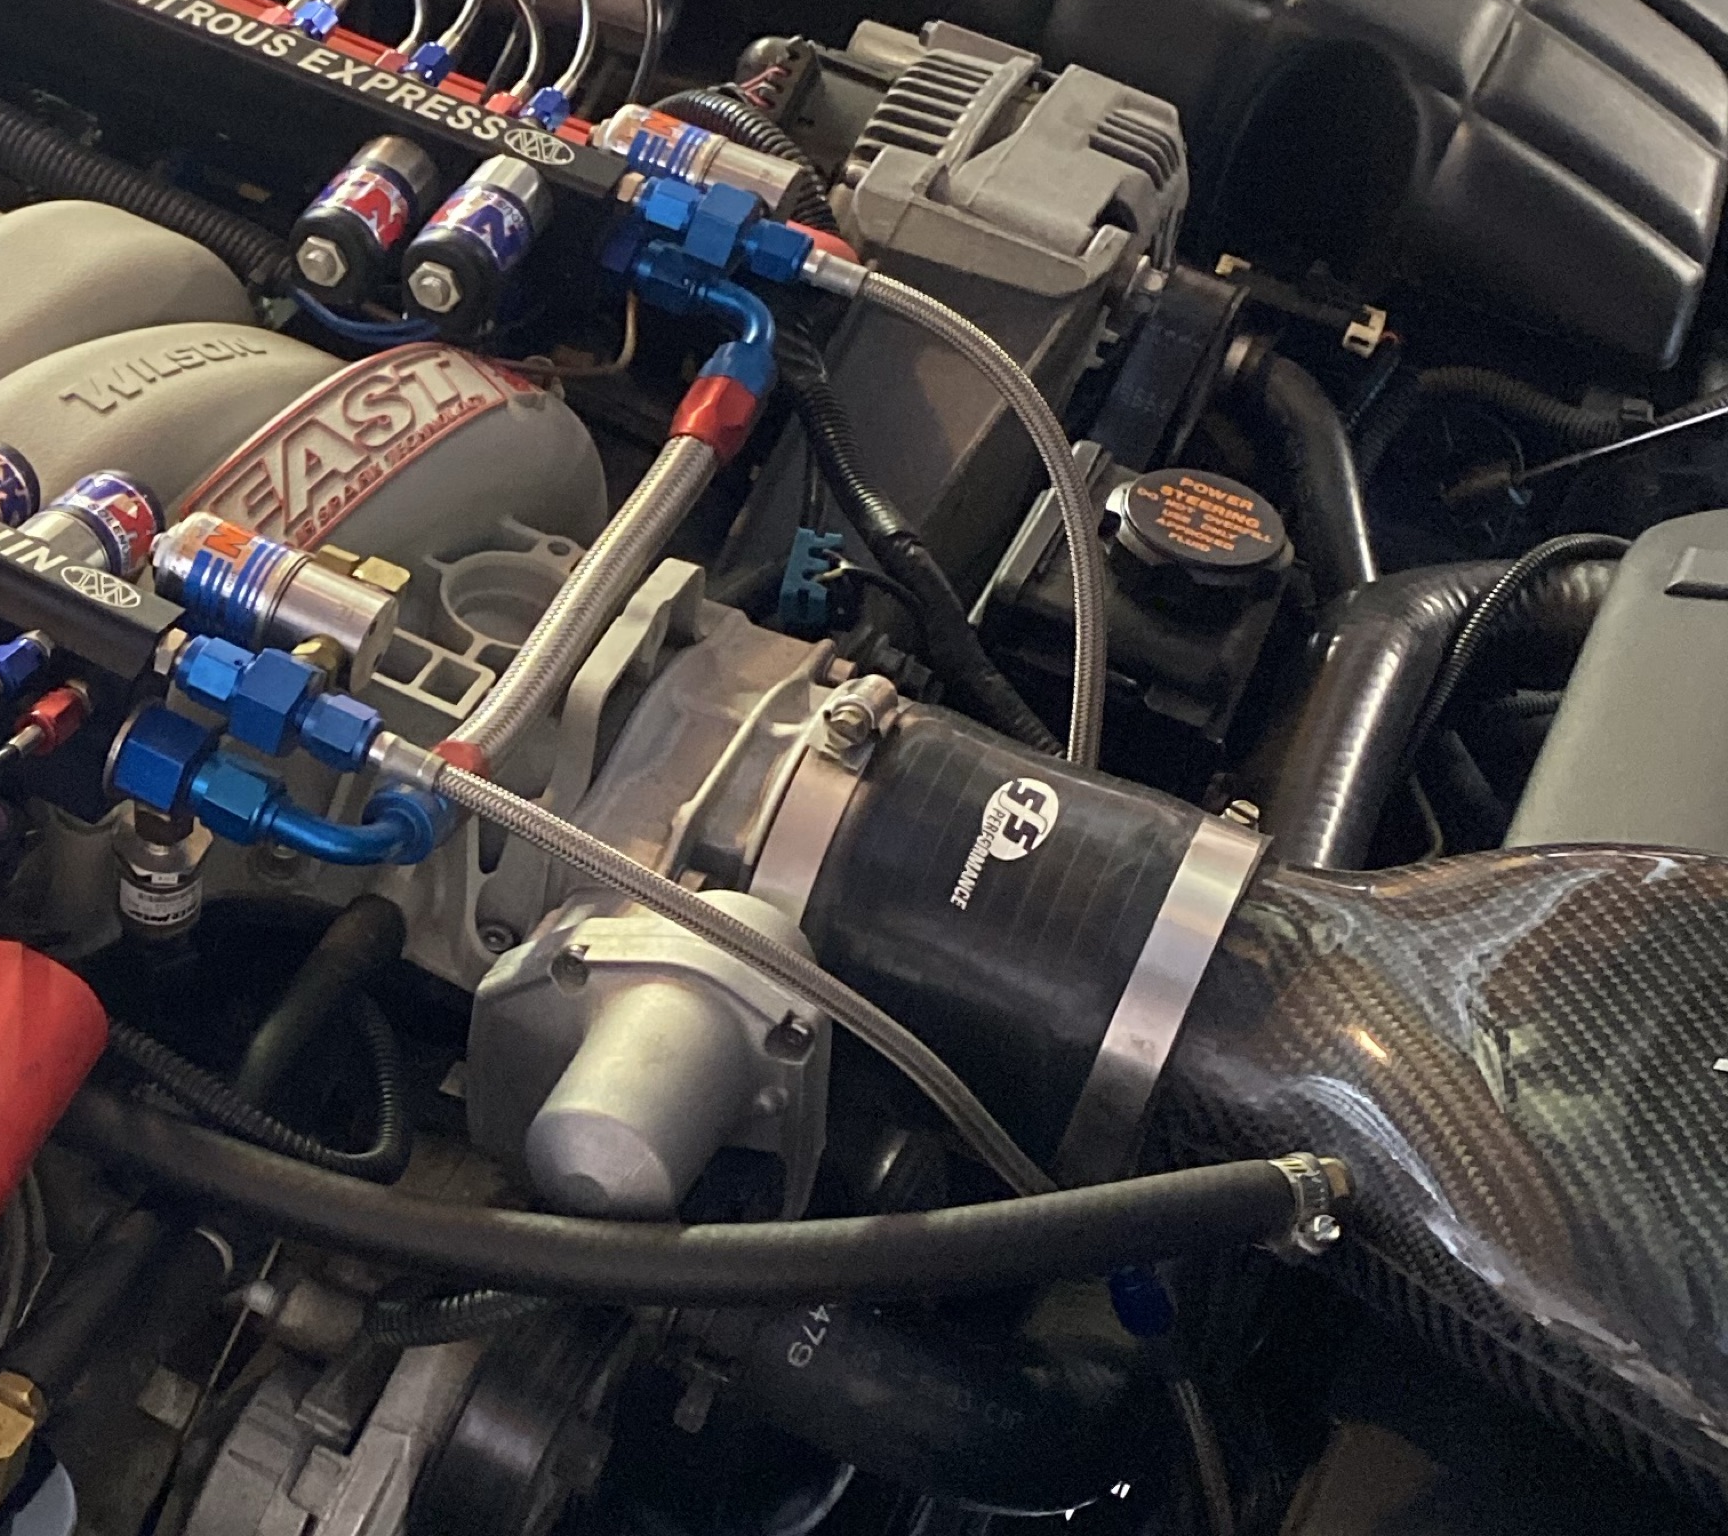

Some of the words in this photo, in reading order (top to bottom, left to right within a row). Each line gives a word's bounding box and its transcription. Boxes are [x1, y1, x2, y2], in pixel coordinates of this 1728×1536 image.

[296, 45, 508, 143] EXPRESS
[59, 336, 269, 415] WILSON
[1159, 485, 1260, 529] STEERING
[1179, 476, 1254, 512] POWER
[949, 807, 1007, 911] PERFORMANCE
[786, 1301, 839, 1368] 479
